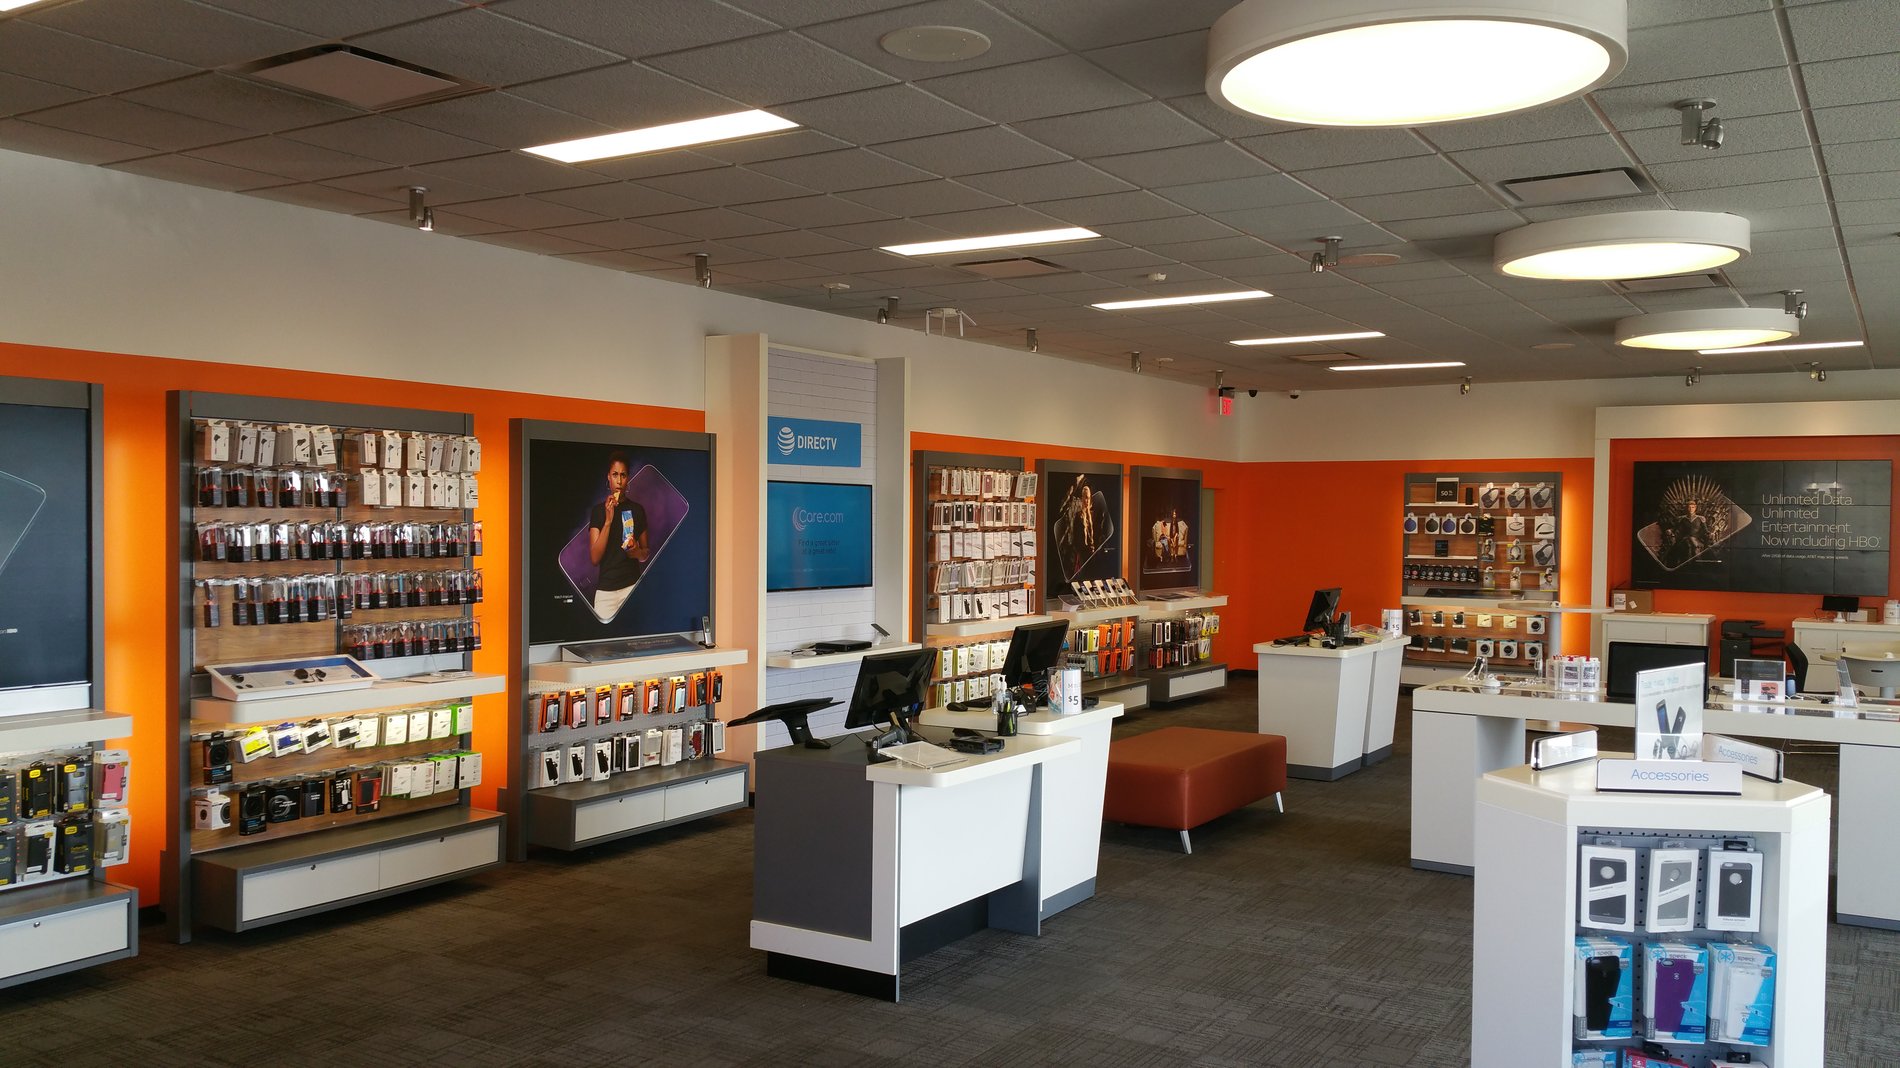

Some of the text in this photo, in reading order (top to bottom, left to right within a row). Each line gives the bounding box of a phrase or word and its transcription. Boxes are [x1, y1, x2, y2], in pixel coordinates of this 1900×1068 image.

[797, 435, 837, 451] DIRECTV
[1762, 493, 1819, 505] Unlimited
[1761, 507, 1819, 519] Unlimited
[1761, 534, 1789, 546] Now
[1792, 534, 1846, 550] including
[1068, 695, 1079, 706] $5
[1718, 744, 1758, 765] Accessories
[1631, 768, 1710, 782] Accessories
